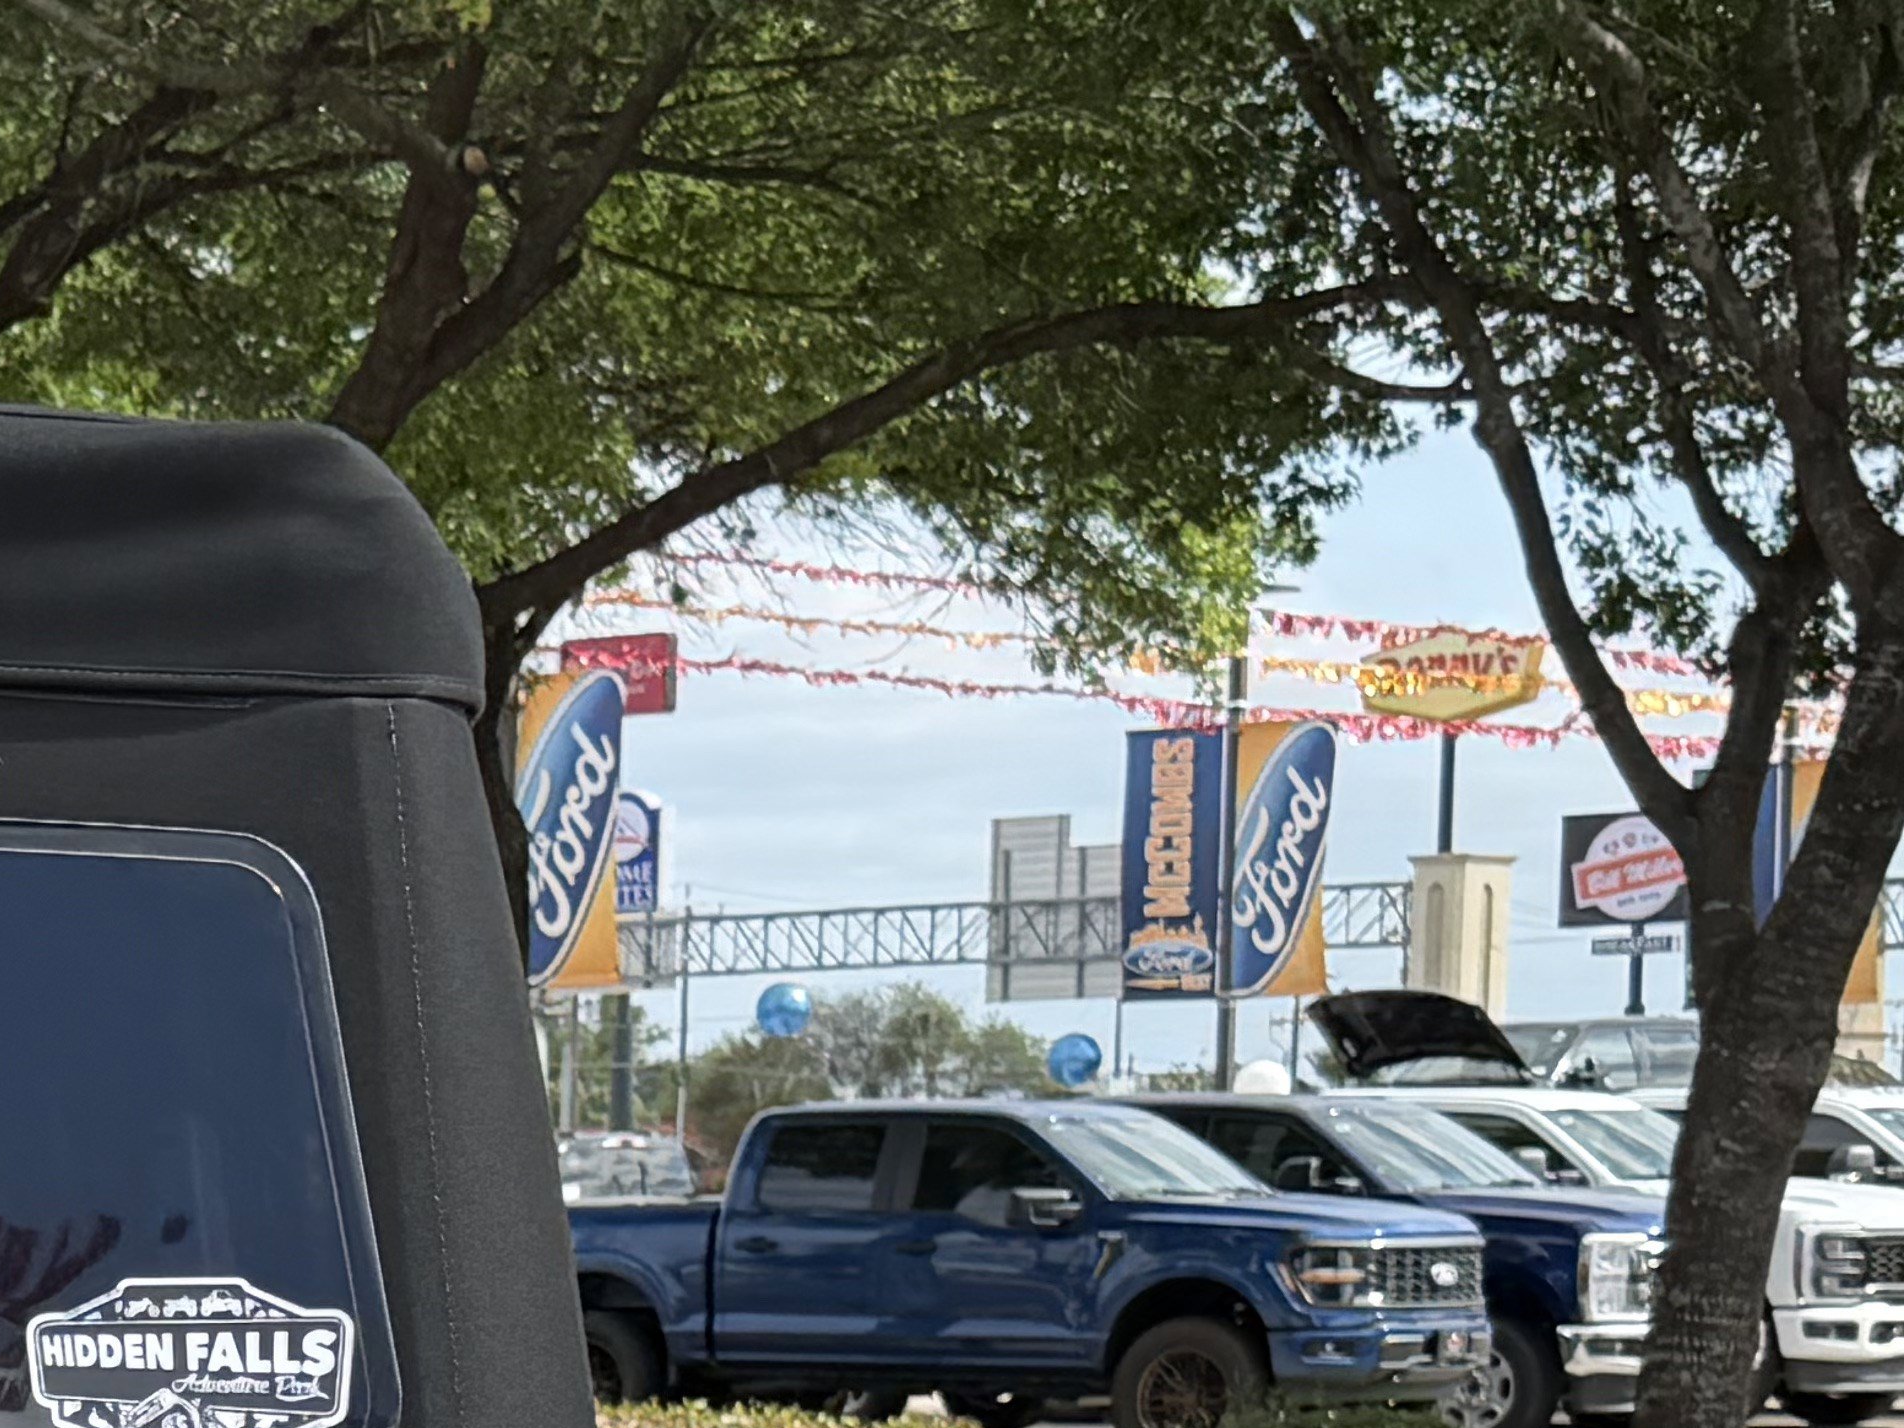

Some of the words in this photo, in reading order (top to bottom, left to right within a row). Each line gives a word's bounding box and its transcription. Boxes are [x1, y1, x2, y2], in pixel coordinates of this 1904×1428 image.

[529, 721, 616, 939] Ford
[1232, 765, 1326, 955] Ford
[41, 1332, 175, 1372] HIDDEN
[185, 1328, 338, 1377] FALLS
[171, 1373, 269, 1396] Adventure
[275, 1374, 330, 1402] Park
